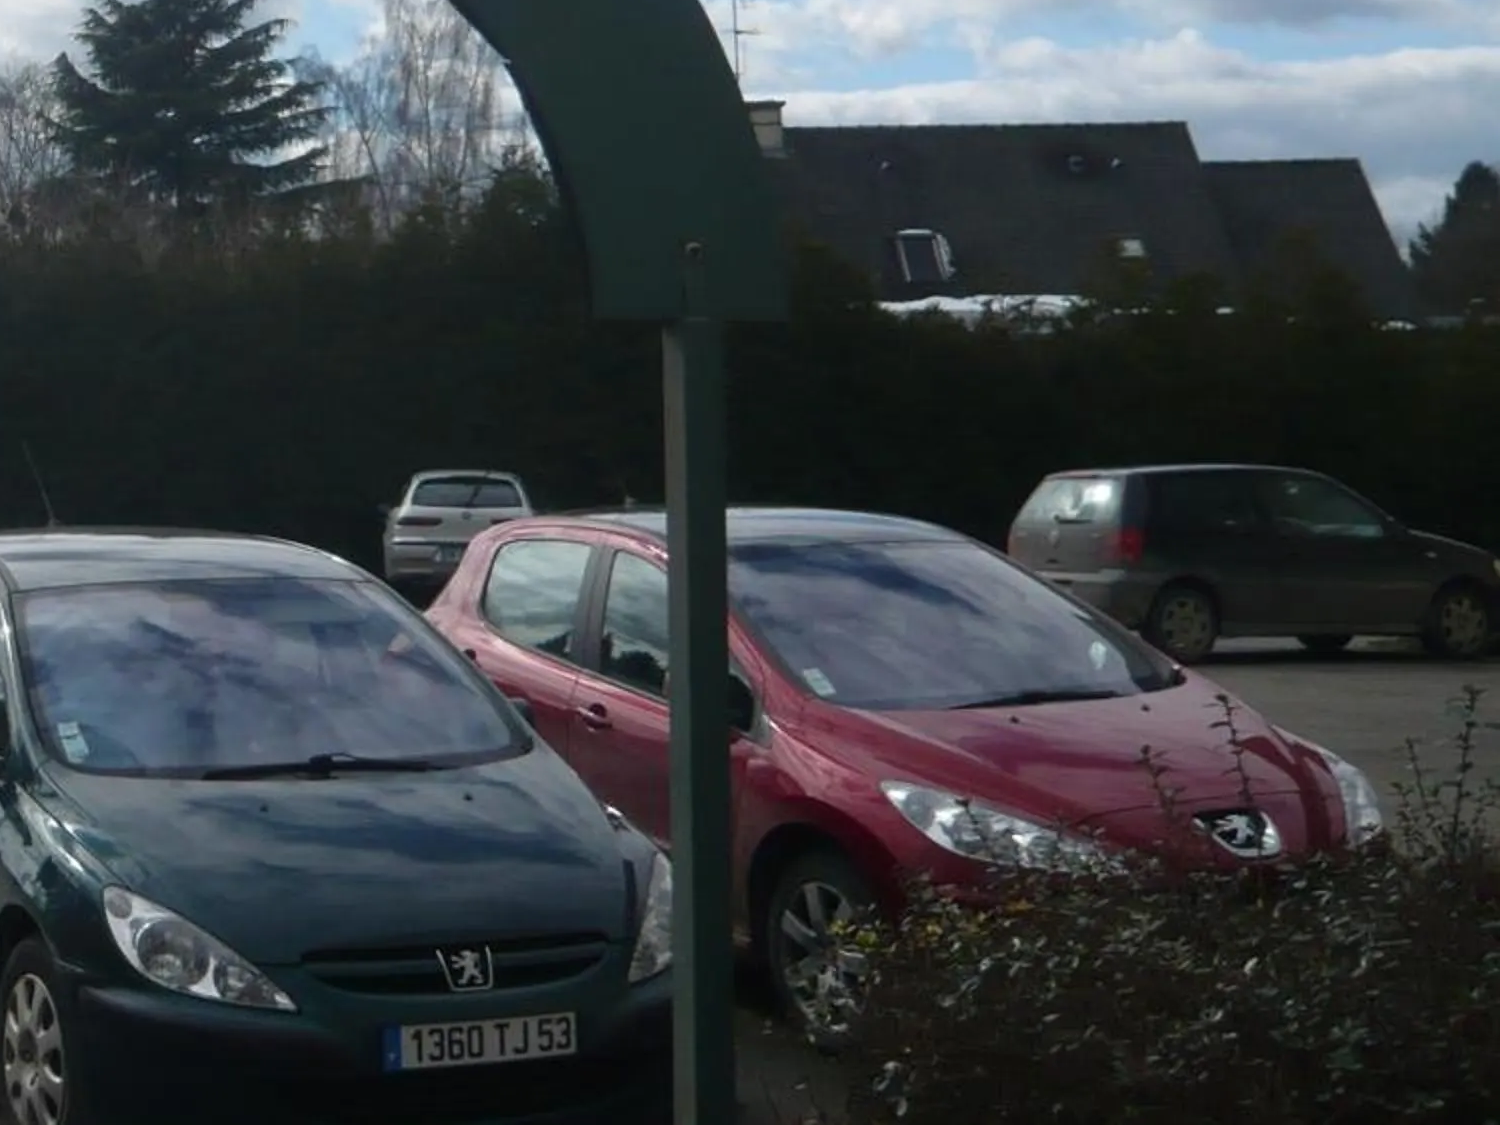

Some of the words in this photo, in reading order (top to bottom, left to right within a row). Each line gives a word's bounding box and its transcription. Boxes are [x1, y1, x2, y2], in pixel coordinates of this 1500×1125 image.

[411, 1025, 484, 1063] 1360
[493, 1021, 529, 1057] TJ
[537, 1016, 572, 1053] 53
